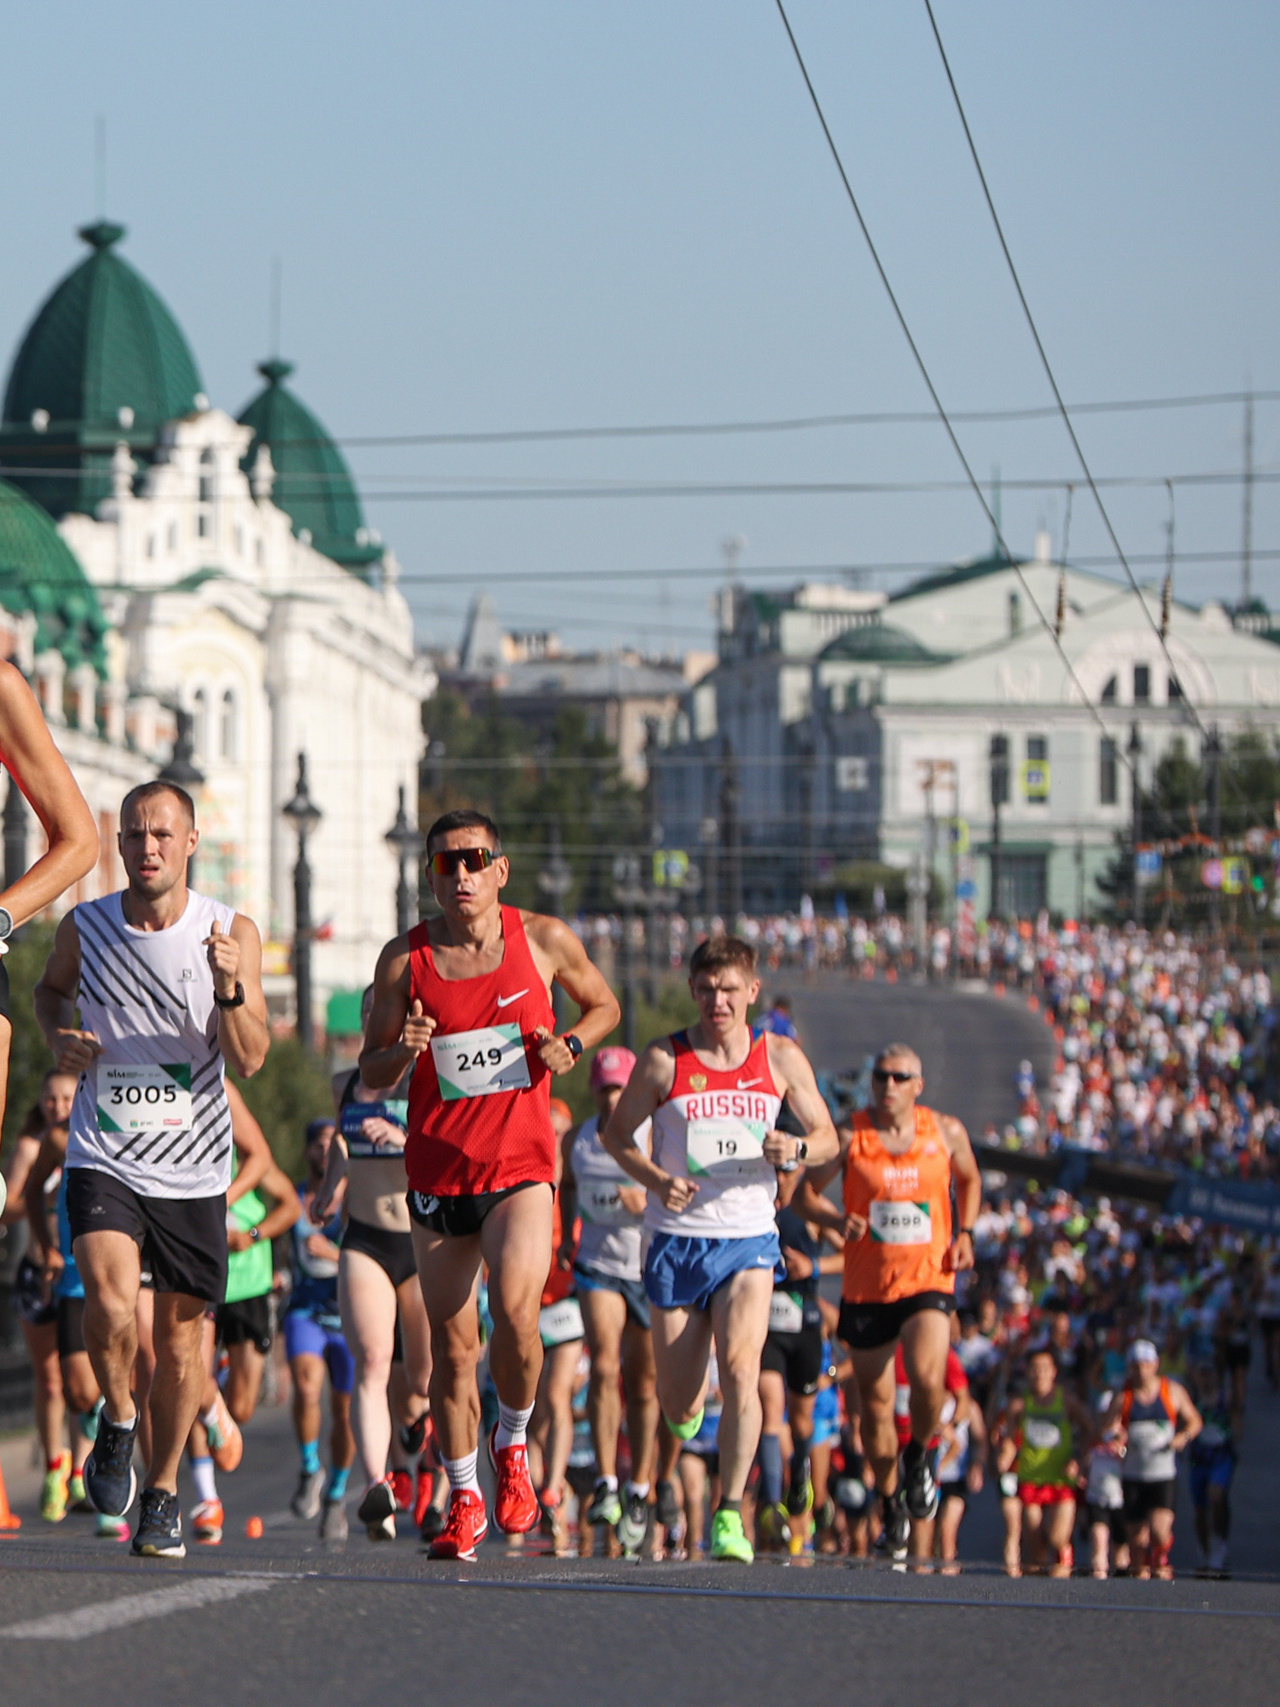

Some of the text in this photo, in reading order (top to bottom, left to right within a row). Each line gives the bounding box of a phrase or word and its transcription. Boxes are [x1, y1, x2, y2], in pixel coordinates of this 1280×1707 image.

[456, 1047, 502, 1072] 249
[110, 1084, 176, 1105] 3005
[686, 1094, 767, 1122] RUSSIA
[717, 1140, 738, 1155] 19
